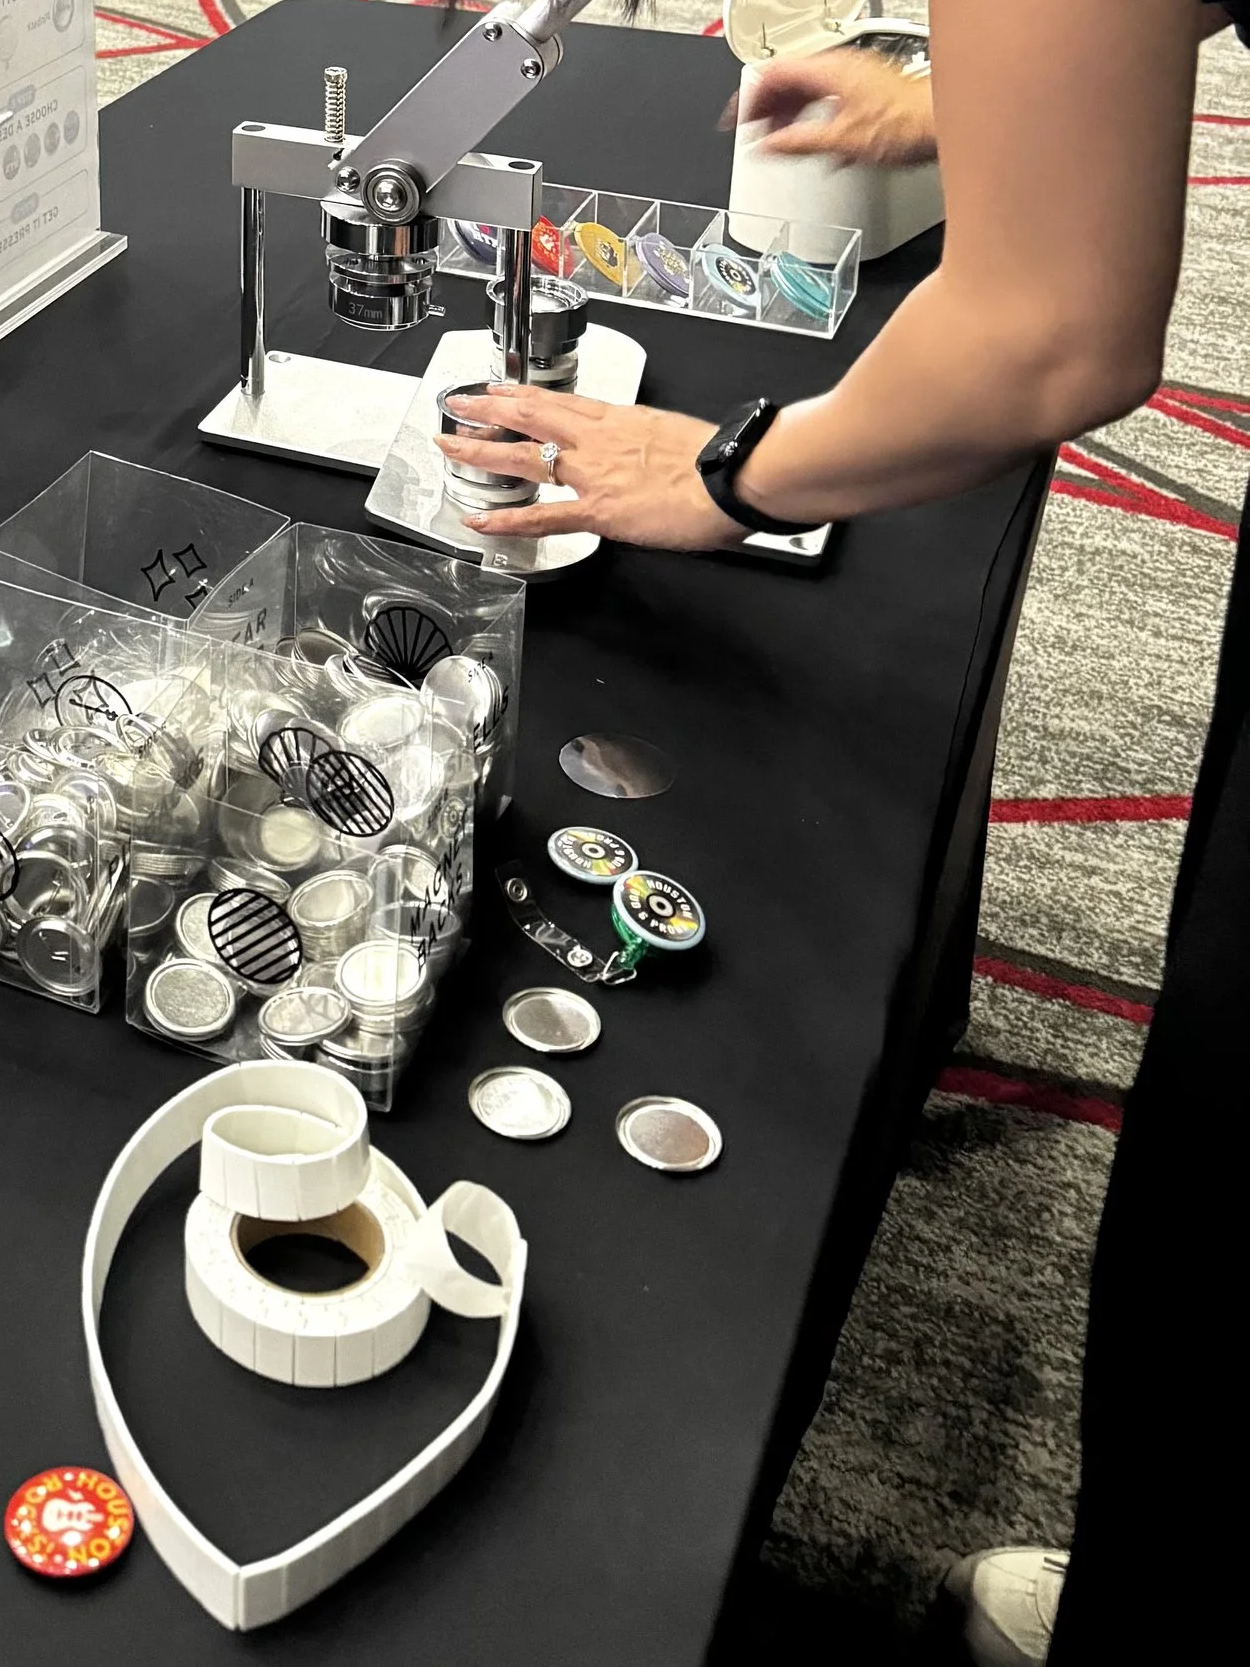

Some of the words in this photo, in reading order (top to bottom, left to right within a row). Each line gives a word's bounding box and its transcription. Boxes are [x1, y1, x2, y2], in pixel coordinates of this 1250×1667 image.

[348, 302, 383, 319] 37mm
[411, 806, 468, 943] MAGNET
[646, 879, 693, 919] HOUSTON
